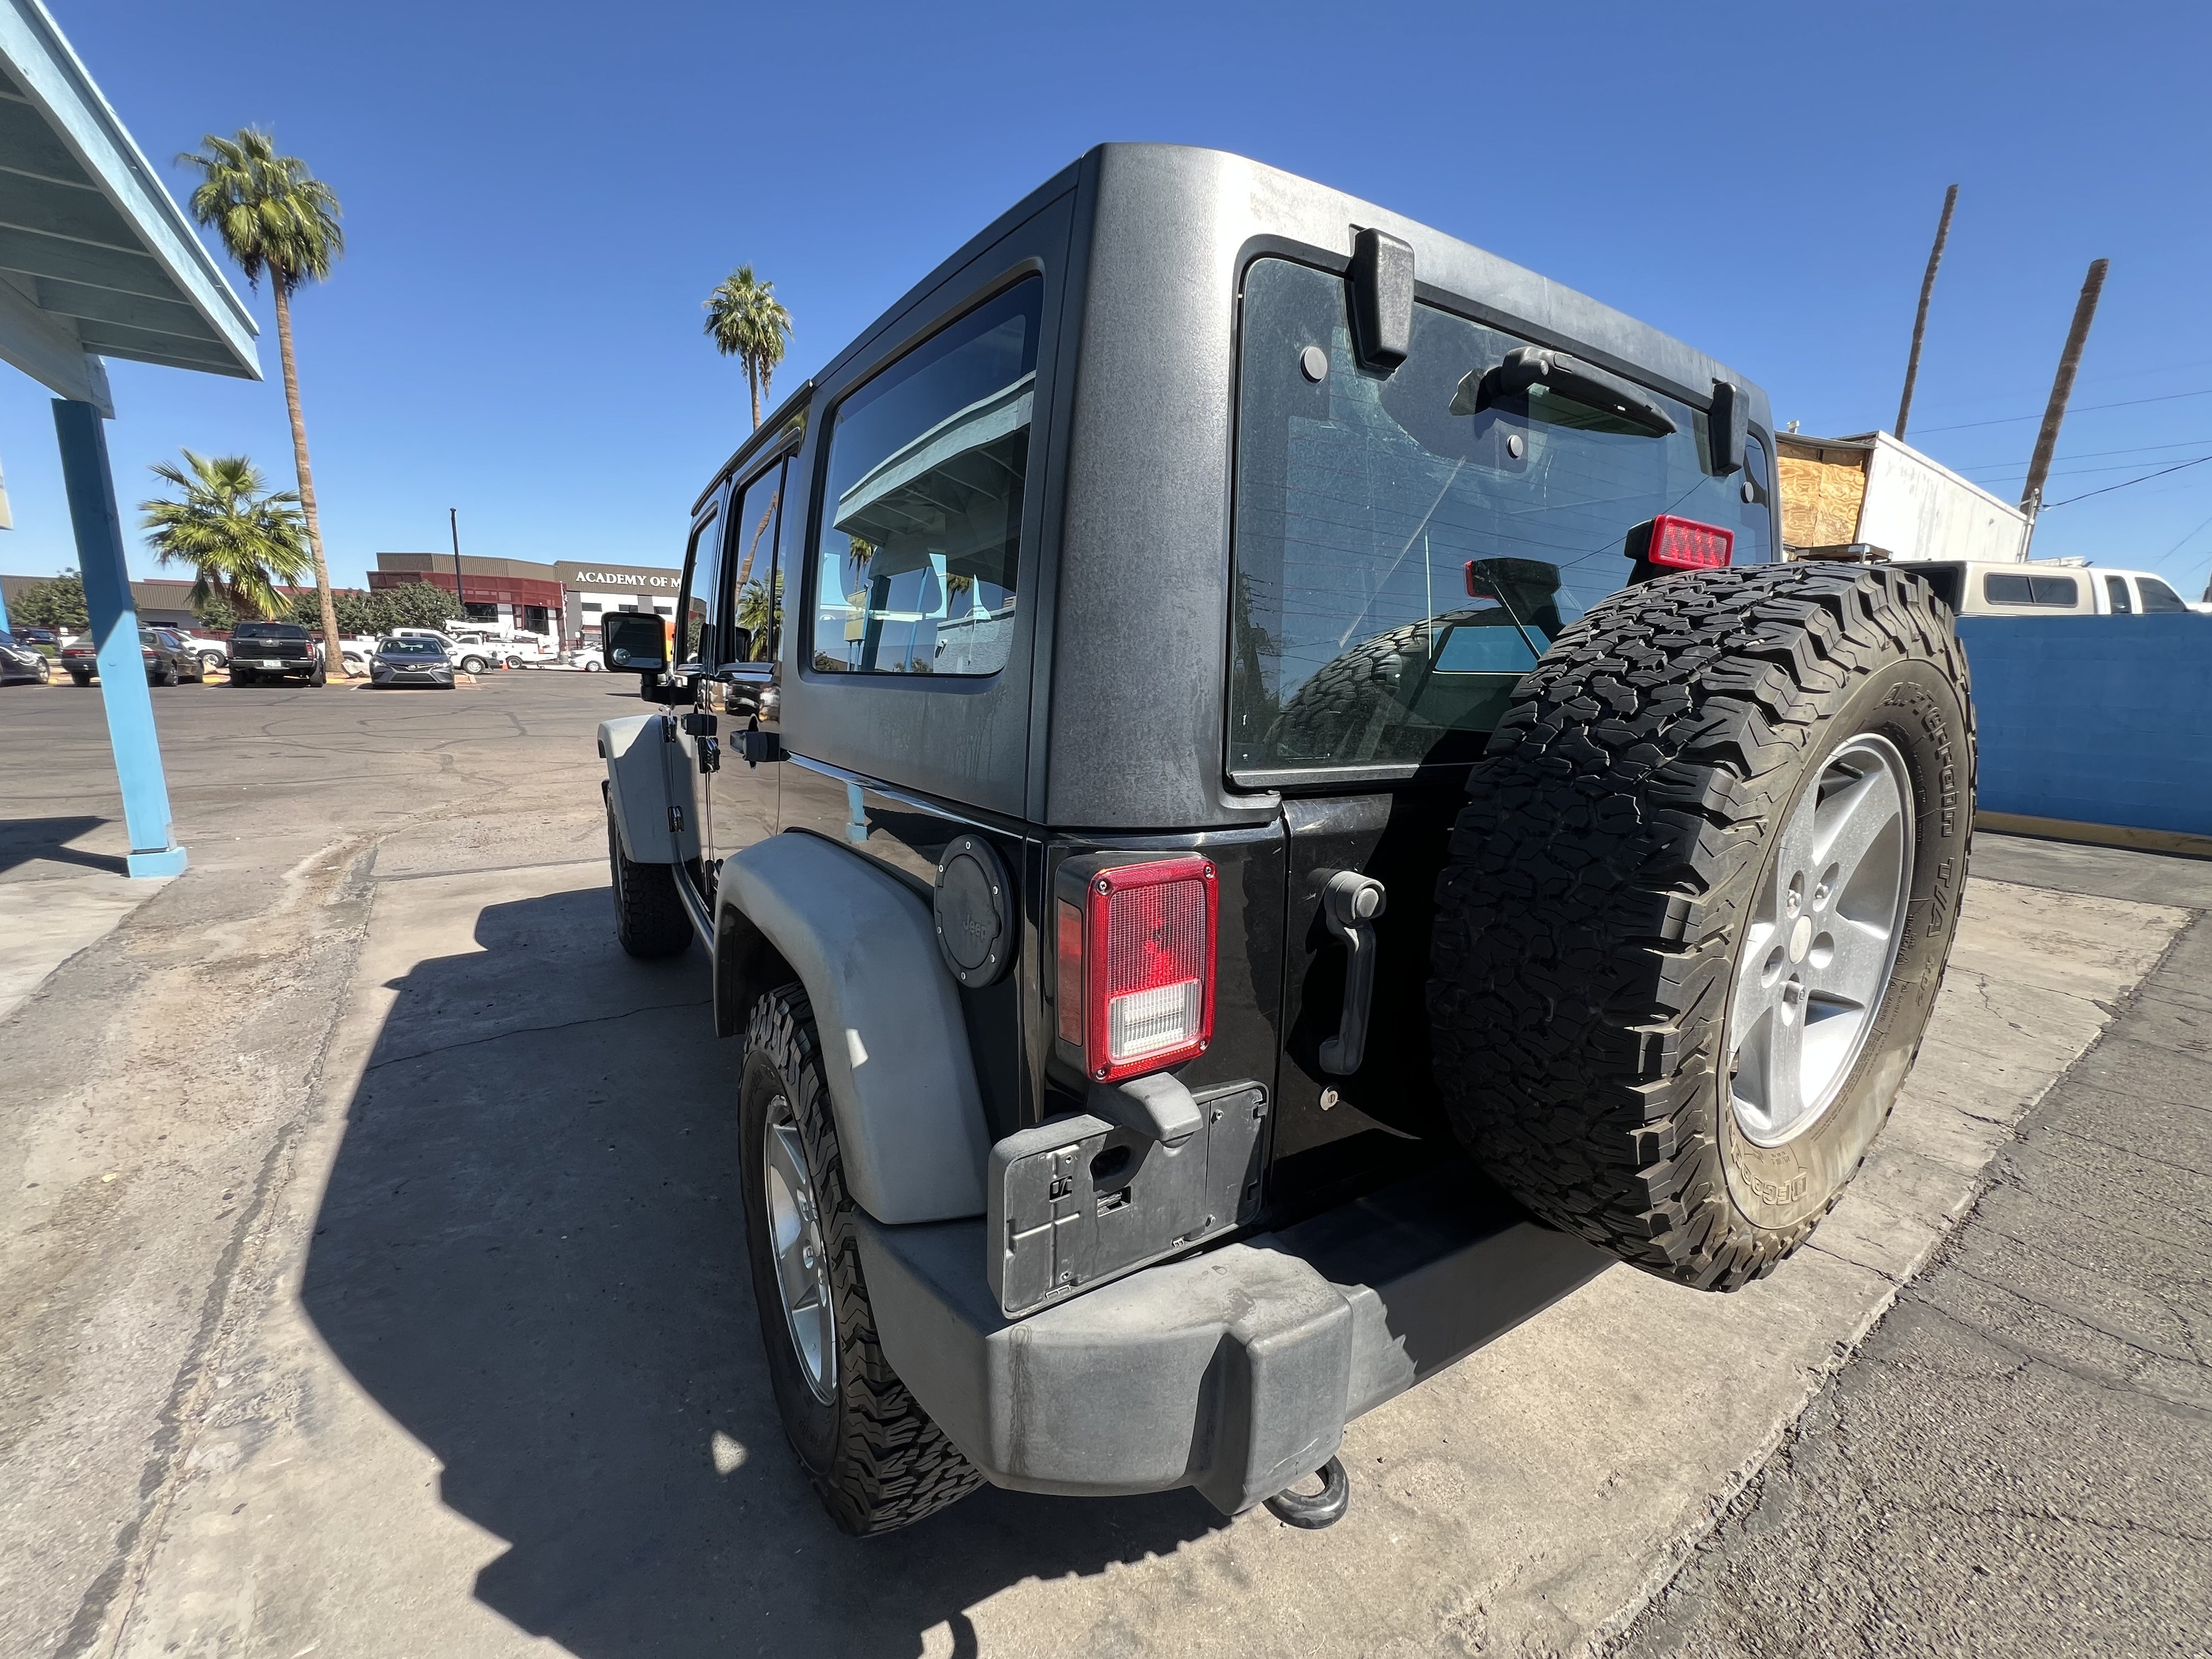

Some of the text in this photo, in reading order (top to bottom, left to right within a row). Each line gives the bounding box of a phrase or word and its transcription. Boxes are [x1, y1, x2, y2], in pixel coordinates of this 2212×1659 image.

[575, 571, 647, 586] ACADEMY
[650, 577, 668, 588] OF
[1927, 856, 1955, 938] T/A
[963, 914, 987, 940] Jeep
